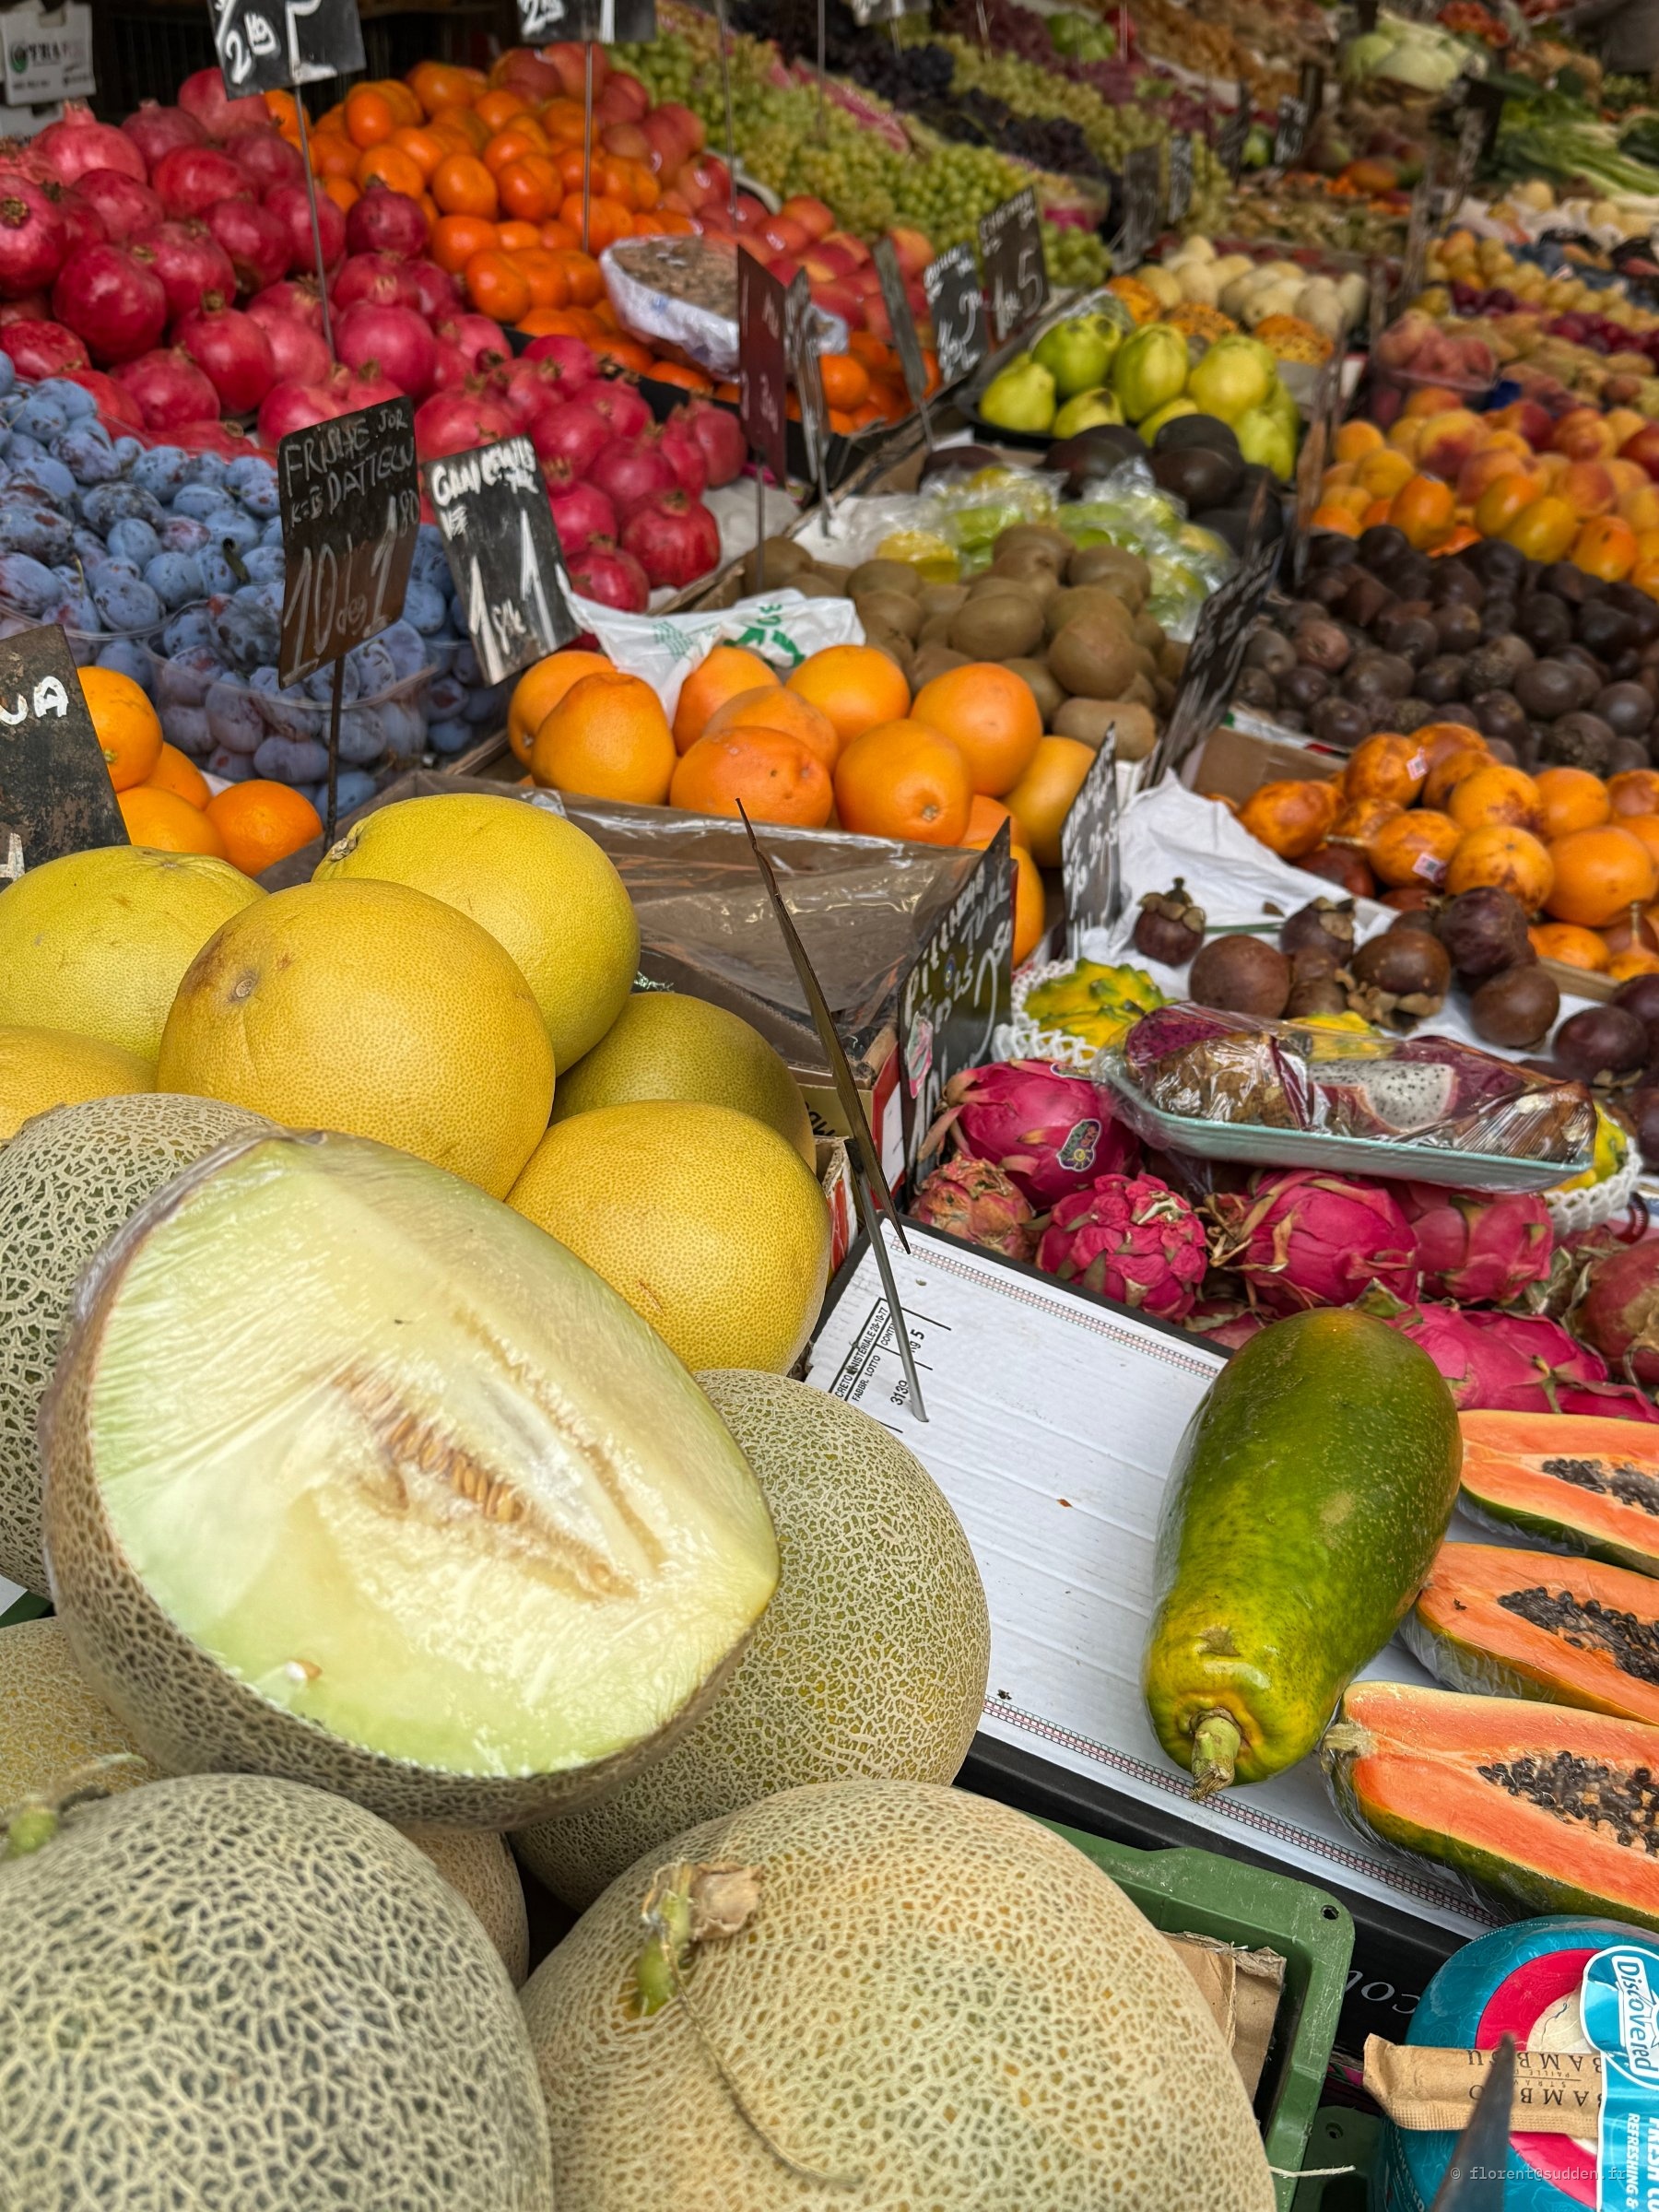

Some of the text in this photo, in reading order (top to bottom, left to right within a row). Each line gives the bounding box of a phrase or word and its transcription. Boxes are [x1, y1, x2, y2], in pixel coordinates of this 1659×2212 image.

[911, 1328, 925, 1340] 5
[852, 1354, 881, 1402] FABBR. LOTTO
[1616, 1959, 1659, 2073] Discovered
[1626, 2112, 1641, 2210] REFRESHING &
